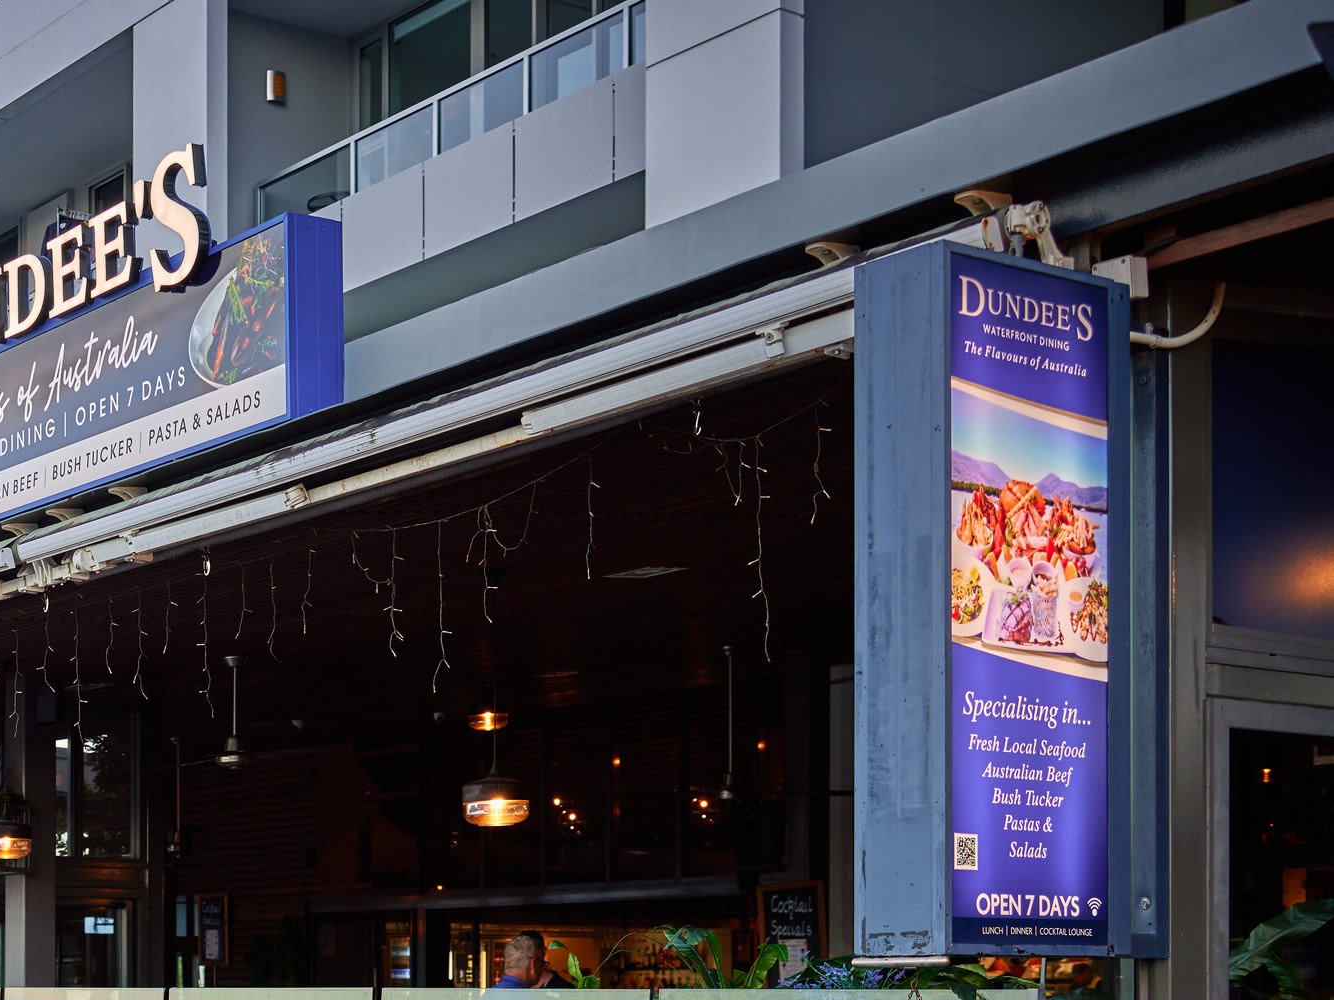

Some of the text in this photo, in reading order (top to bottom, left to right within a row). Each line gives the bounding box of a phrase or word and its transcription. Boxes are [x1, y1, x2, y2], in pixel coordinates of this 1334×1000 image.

[958, 275, 1093, 342] DUNDEE'S
[982, 323, 1070, 352] WATERFRONT DINING
[16, 361, 40, 423] of
[44, 315, 159, 412] Australia
[964, 340, 1087, 378] The Flavours of Australia
[0, 420, 56, 457] DINING
[75, 391, 120, 427] OPEN
[127, 385, 136, 408] 7
[141, 366, 187, 402] DAYS
[12, 471, 39, 495] BEEF
[52, 454, 81, 480] BUSH
[85, 437, 133, 469] TUCKER
[148, 418, 187, 446] PASTA
[192, 413, 202, 431] &
[206, 391, 262, 426] SALADS
[962, 691, 1091, 729] Specialising in...
[968, 733, 1086, 761] Fresh Local Seafood
[982, 761, 1074, 788] Australian Beef
[992, 788, 1065, 808] Bush Tucker
[1003, 814, 1054, 833] Pastas &
[1009, 841, 1048, 859] Salads
[771, 895, 813, 920] Cocktail
[976, 893, 1080, 917] OPEN 7 DAYS
[770, 919, 813, 939] Specials
[982, 926, 1093, 936] LUNCH DINNER COCKTAIL LOUNGE
